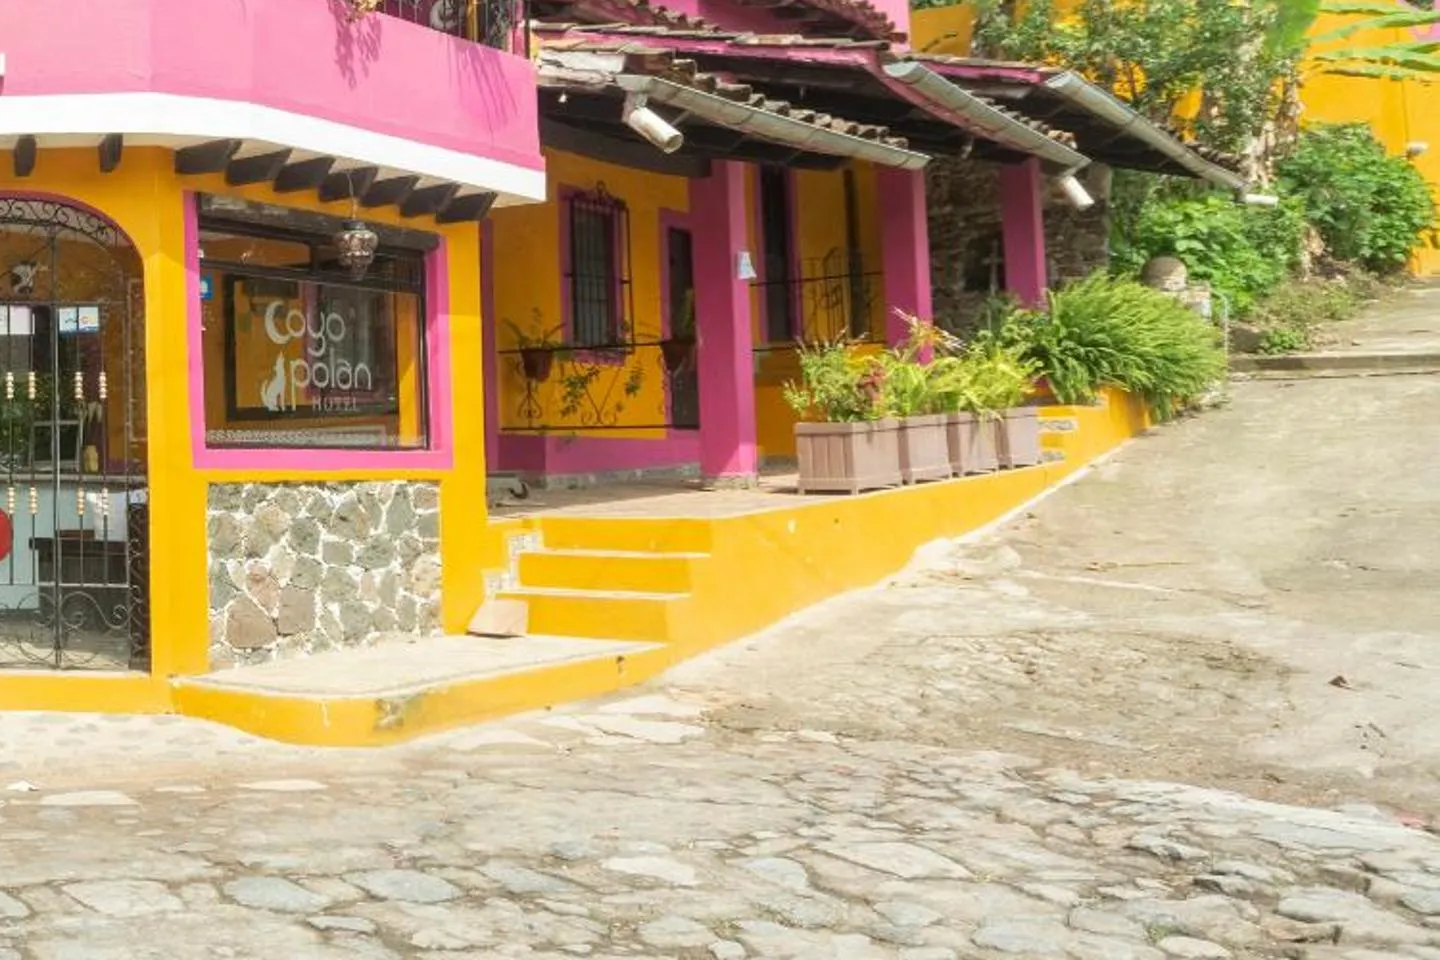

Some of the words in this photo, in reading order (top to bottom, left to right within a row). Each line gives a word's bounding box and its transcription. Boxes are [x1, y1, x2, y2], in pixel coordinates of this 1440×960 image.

[264, 300, 347, 357] Coyo
[289, 348, 373, 412] polan
[311, 395, 359, 412] HOTEL
